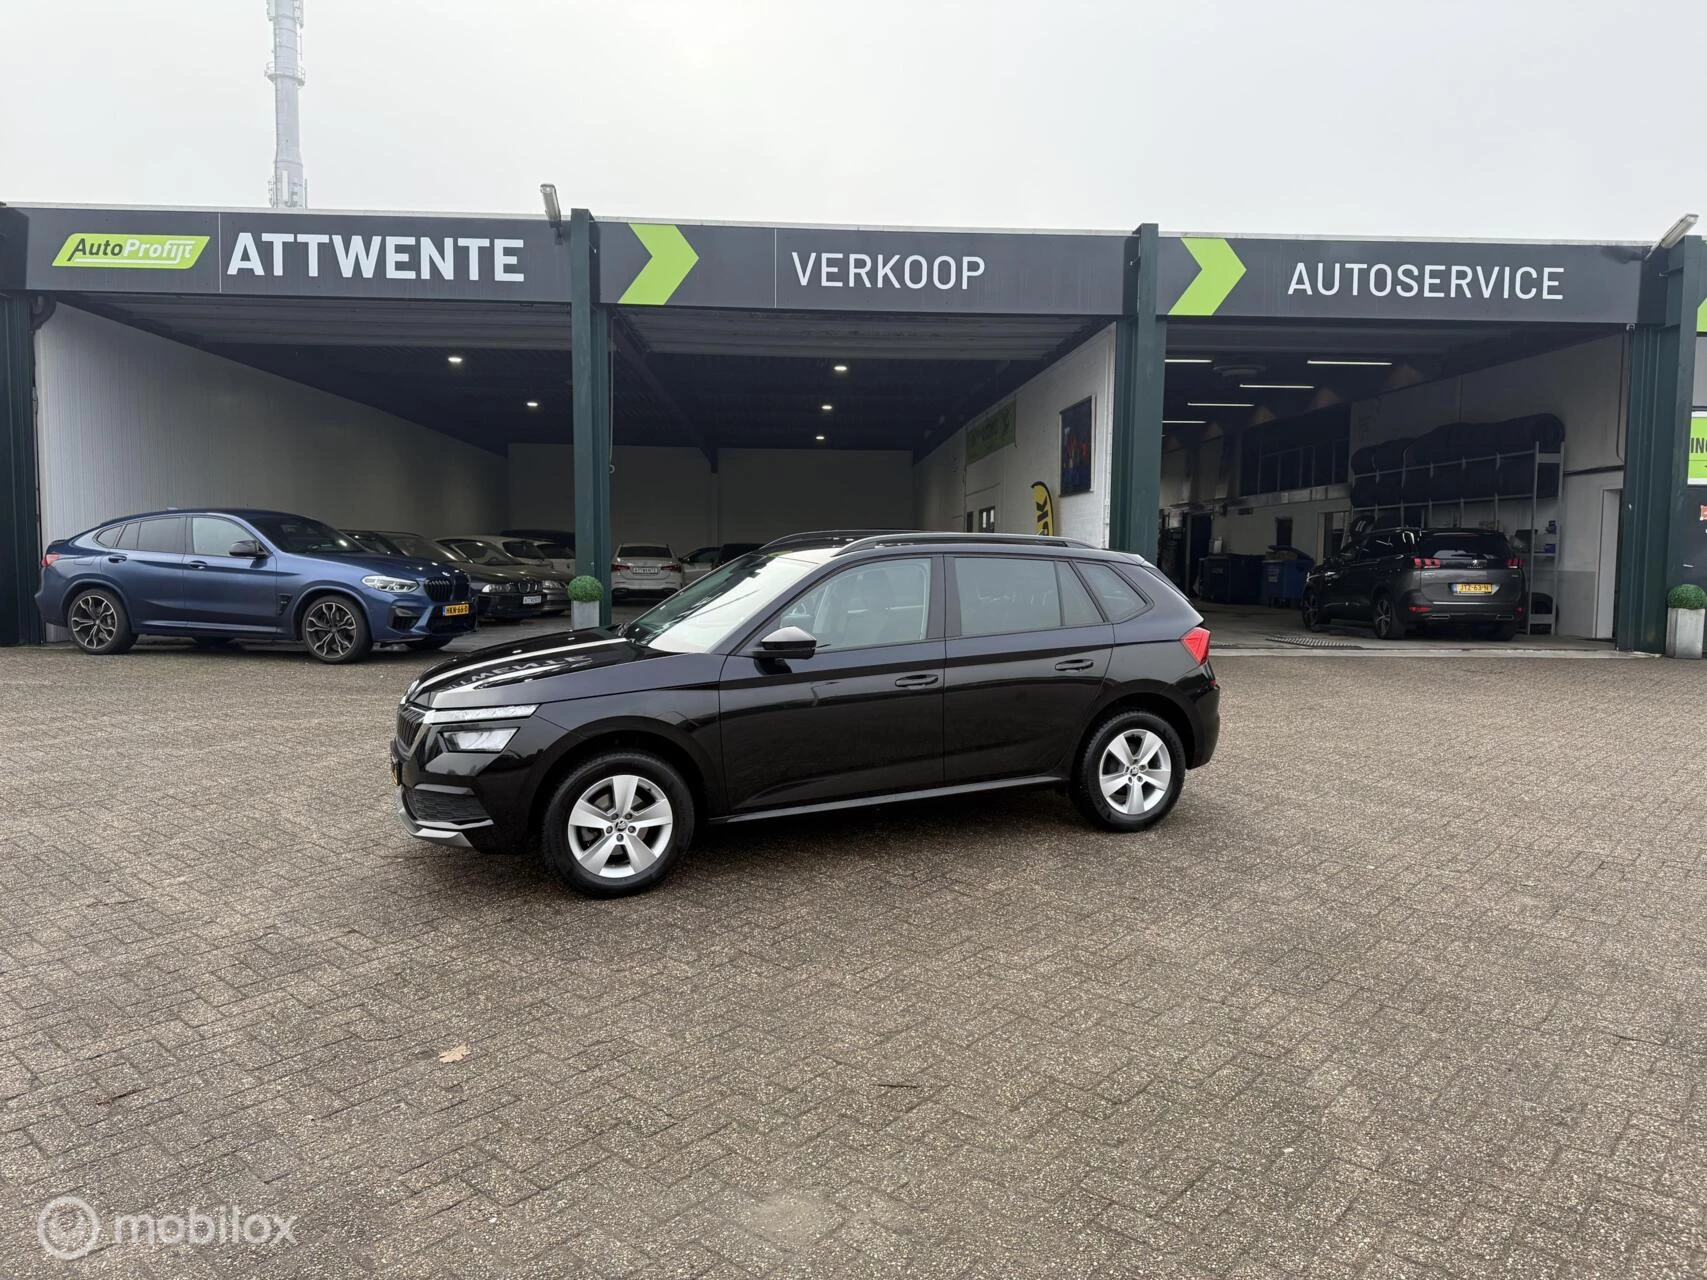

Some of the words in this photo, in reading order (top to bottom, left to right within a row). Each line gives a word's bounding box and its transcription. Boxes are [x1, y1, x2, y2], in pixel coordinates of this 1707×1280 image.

[67, 237, 196, 264] AutoProfijt
[226, 232, 525, 283] ATTWENTE
[791, 251, 986, 291] VERKOOP
[1287, 262, 1565, 301] AUTOSERVICE
[1690, 437, 1707, 454] IN
